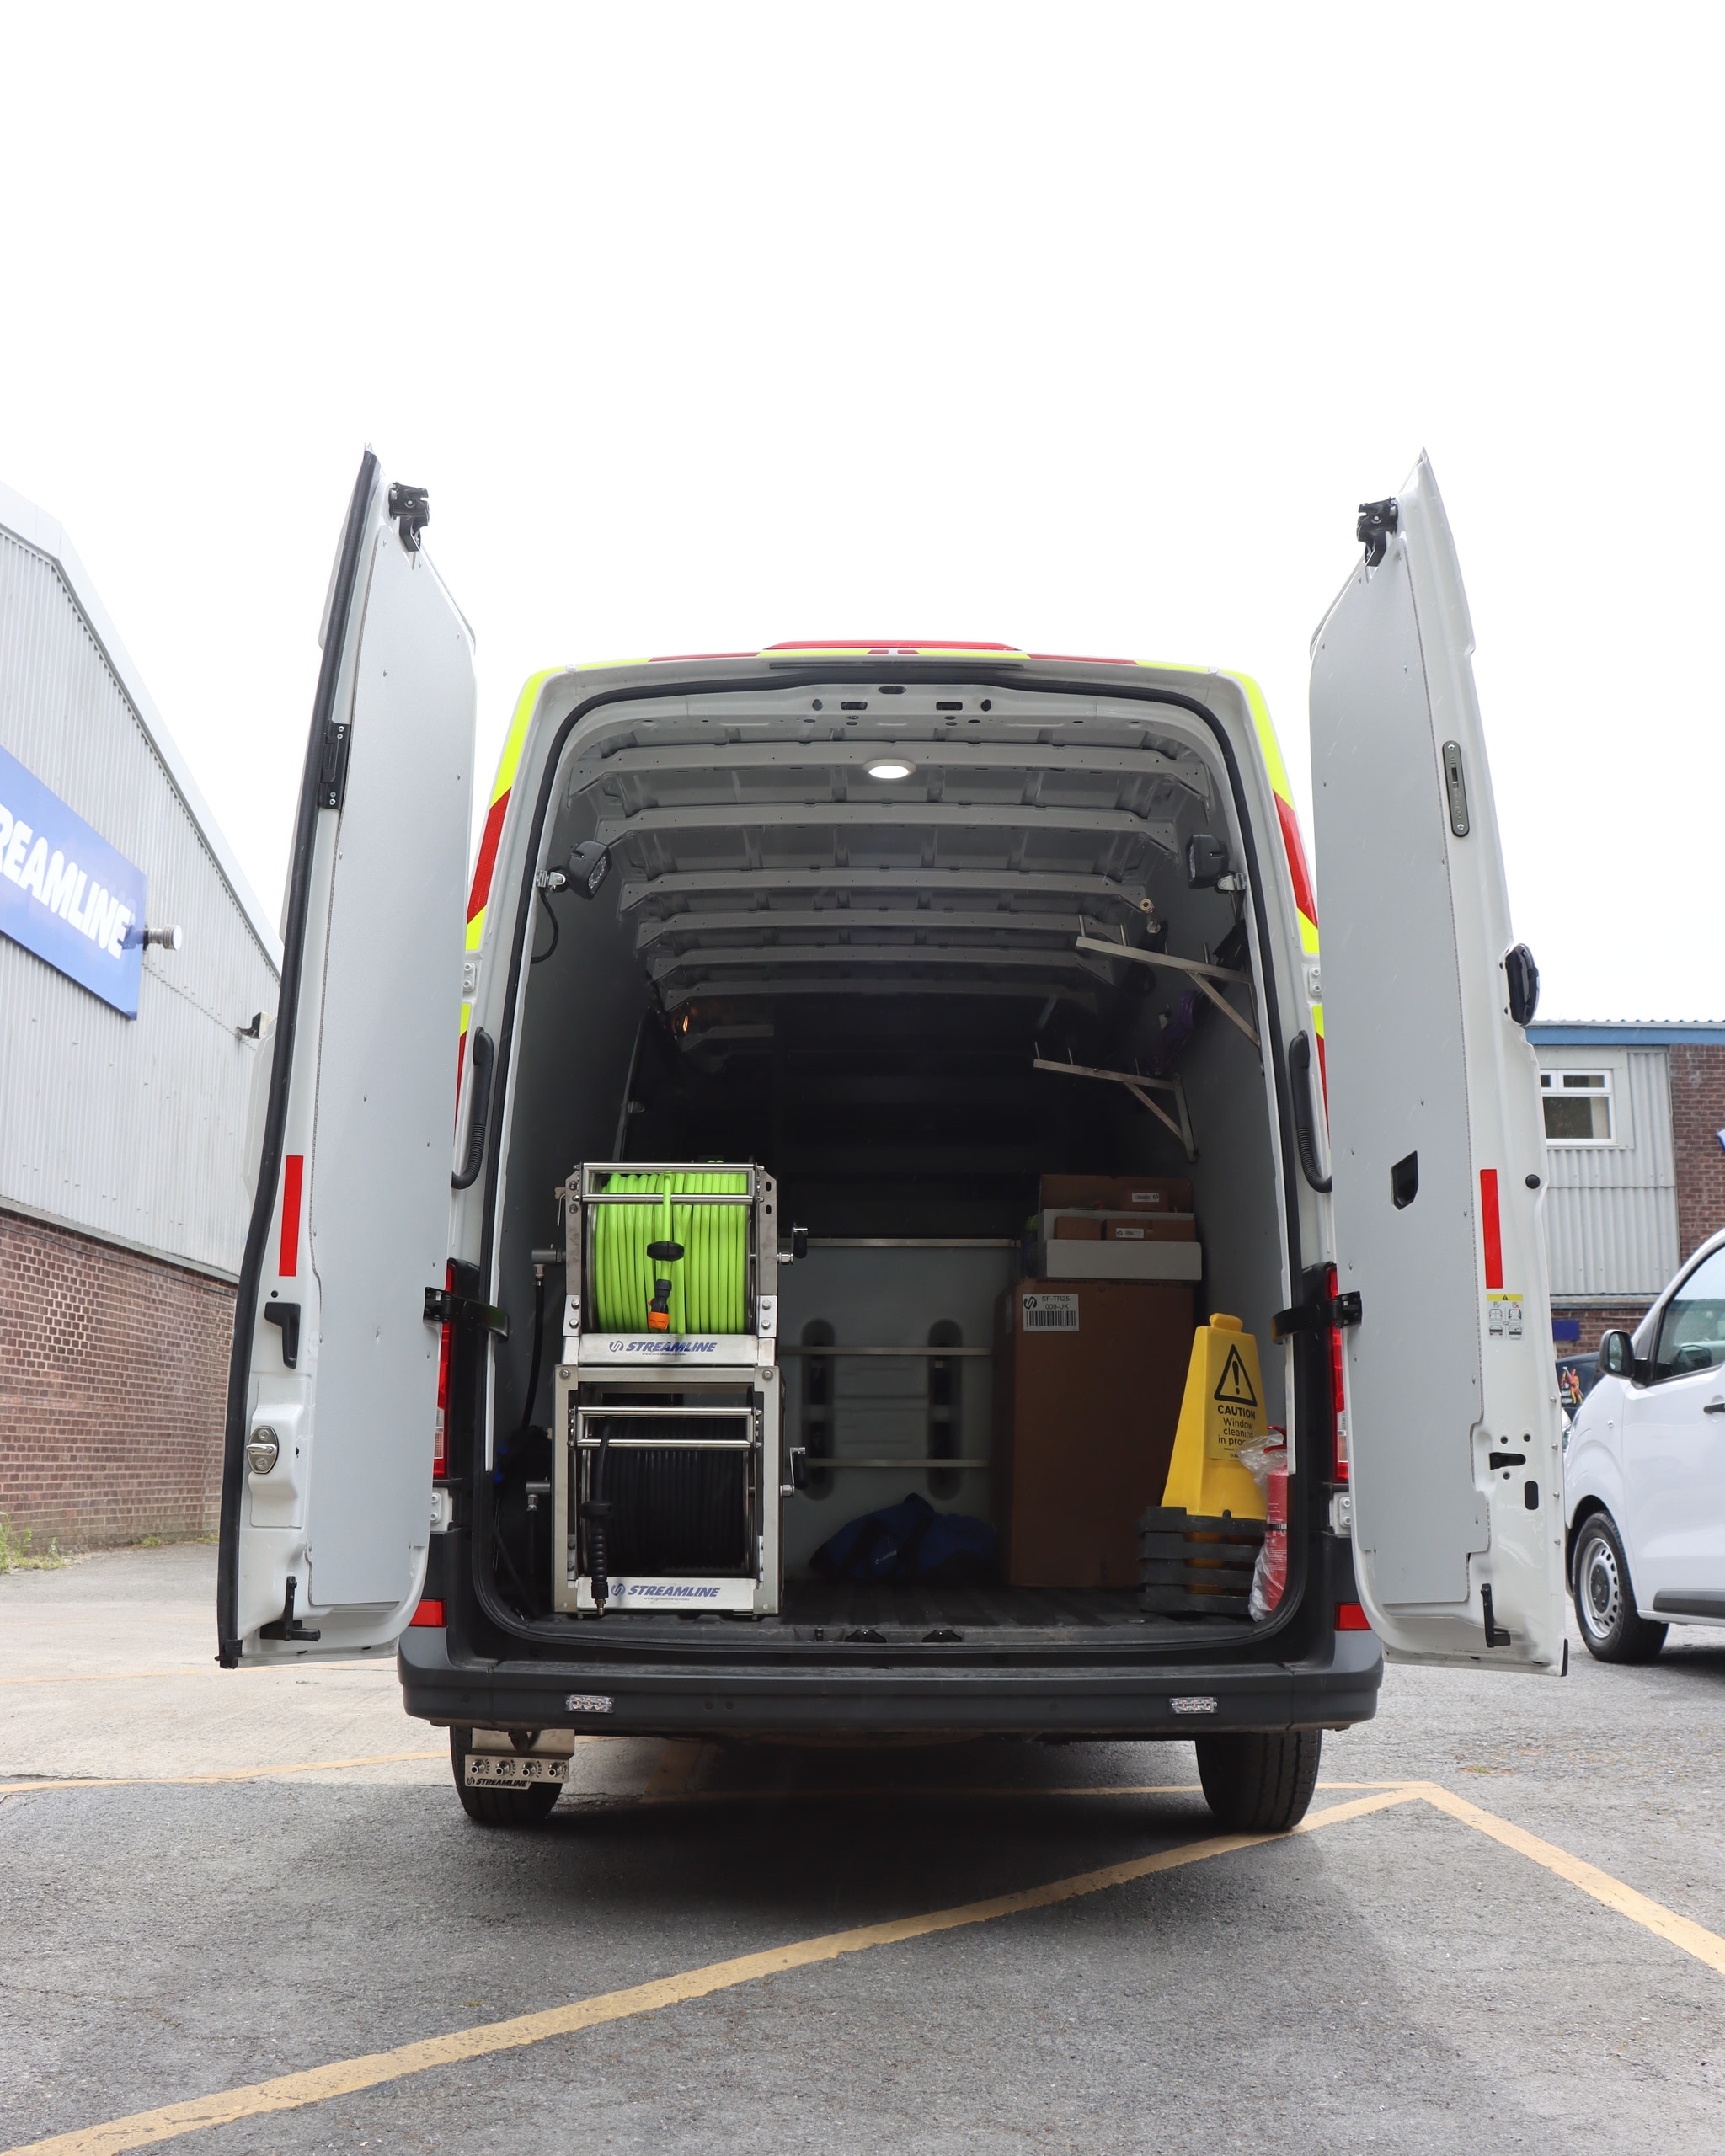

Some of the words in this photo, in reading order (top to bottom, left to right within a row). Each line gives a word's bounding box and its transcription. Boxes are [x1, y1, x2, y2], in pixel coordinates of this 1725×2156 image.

[626, 1342, 718, 1353] STREAMLINE
[1217, 1404, 1256, 1420] CAUTION
[1223, 1417, 1253, 1430] Window
[1218, 1434, 1226, 1444] in
[628, 1585, 721, 1598] STREAMLINE
[476, 1778, 527, 1787] STREAMLINE
